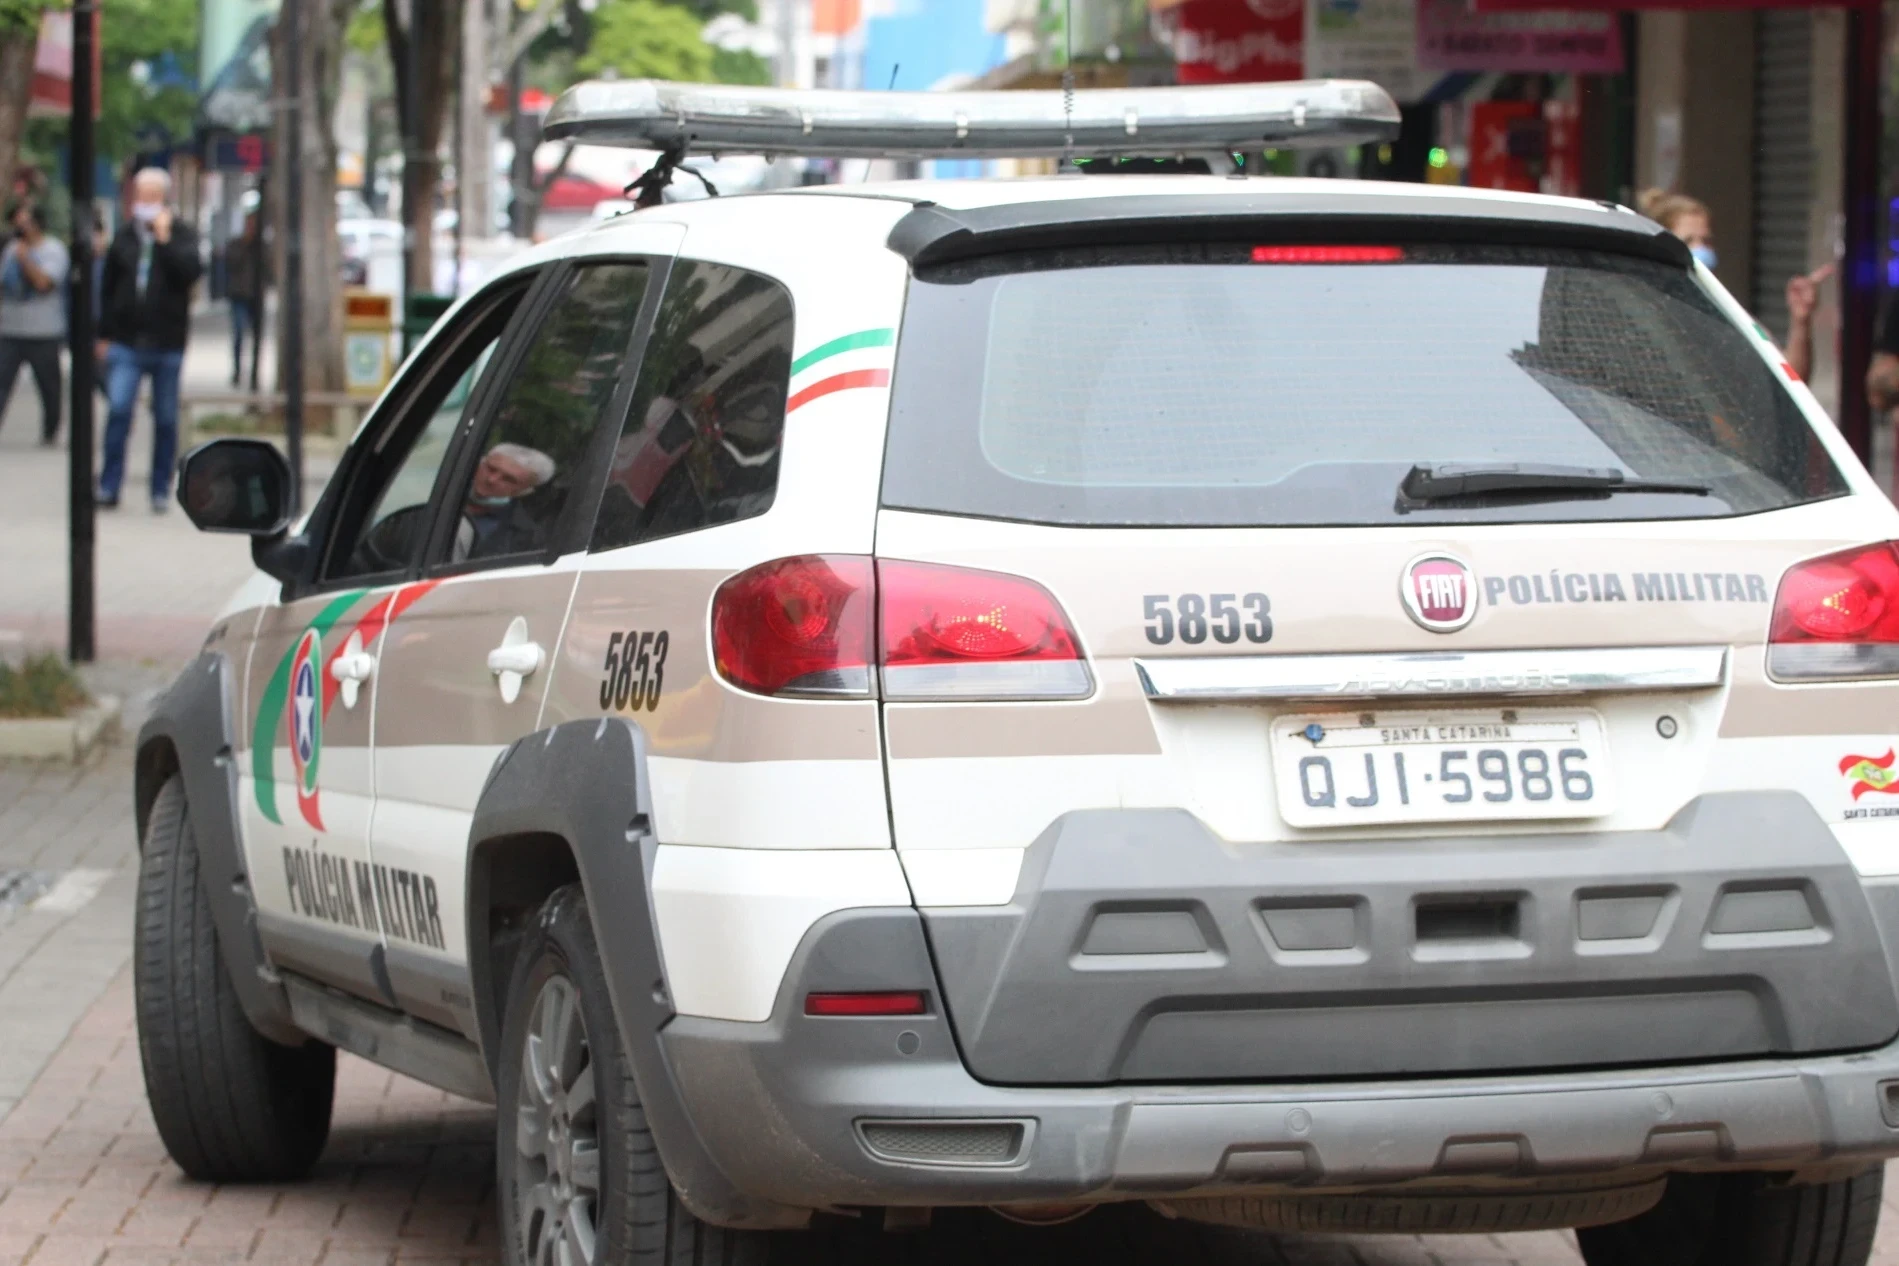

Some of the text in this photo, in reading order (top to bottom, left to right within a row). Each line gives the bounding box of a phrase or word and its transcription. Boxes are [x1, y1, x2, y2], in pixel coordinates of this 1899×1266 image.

[1418, 574, 1465, 609] FIAT
[1483, 569, 1769, 606] POLÍCIA MILITAR
[1143, 592, 1274, 645] 5853
[599, 630, 669, 712] 5853
[1380, 725, 1512, 743] SANTA CATARINA
[283, 837, 447, 951] POLÍCIA MILITAR
